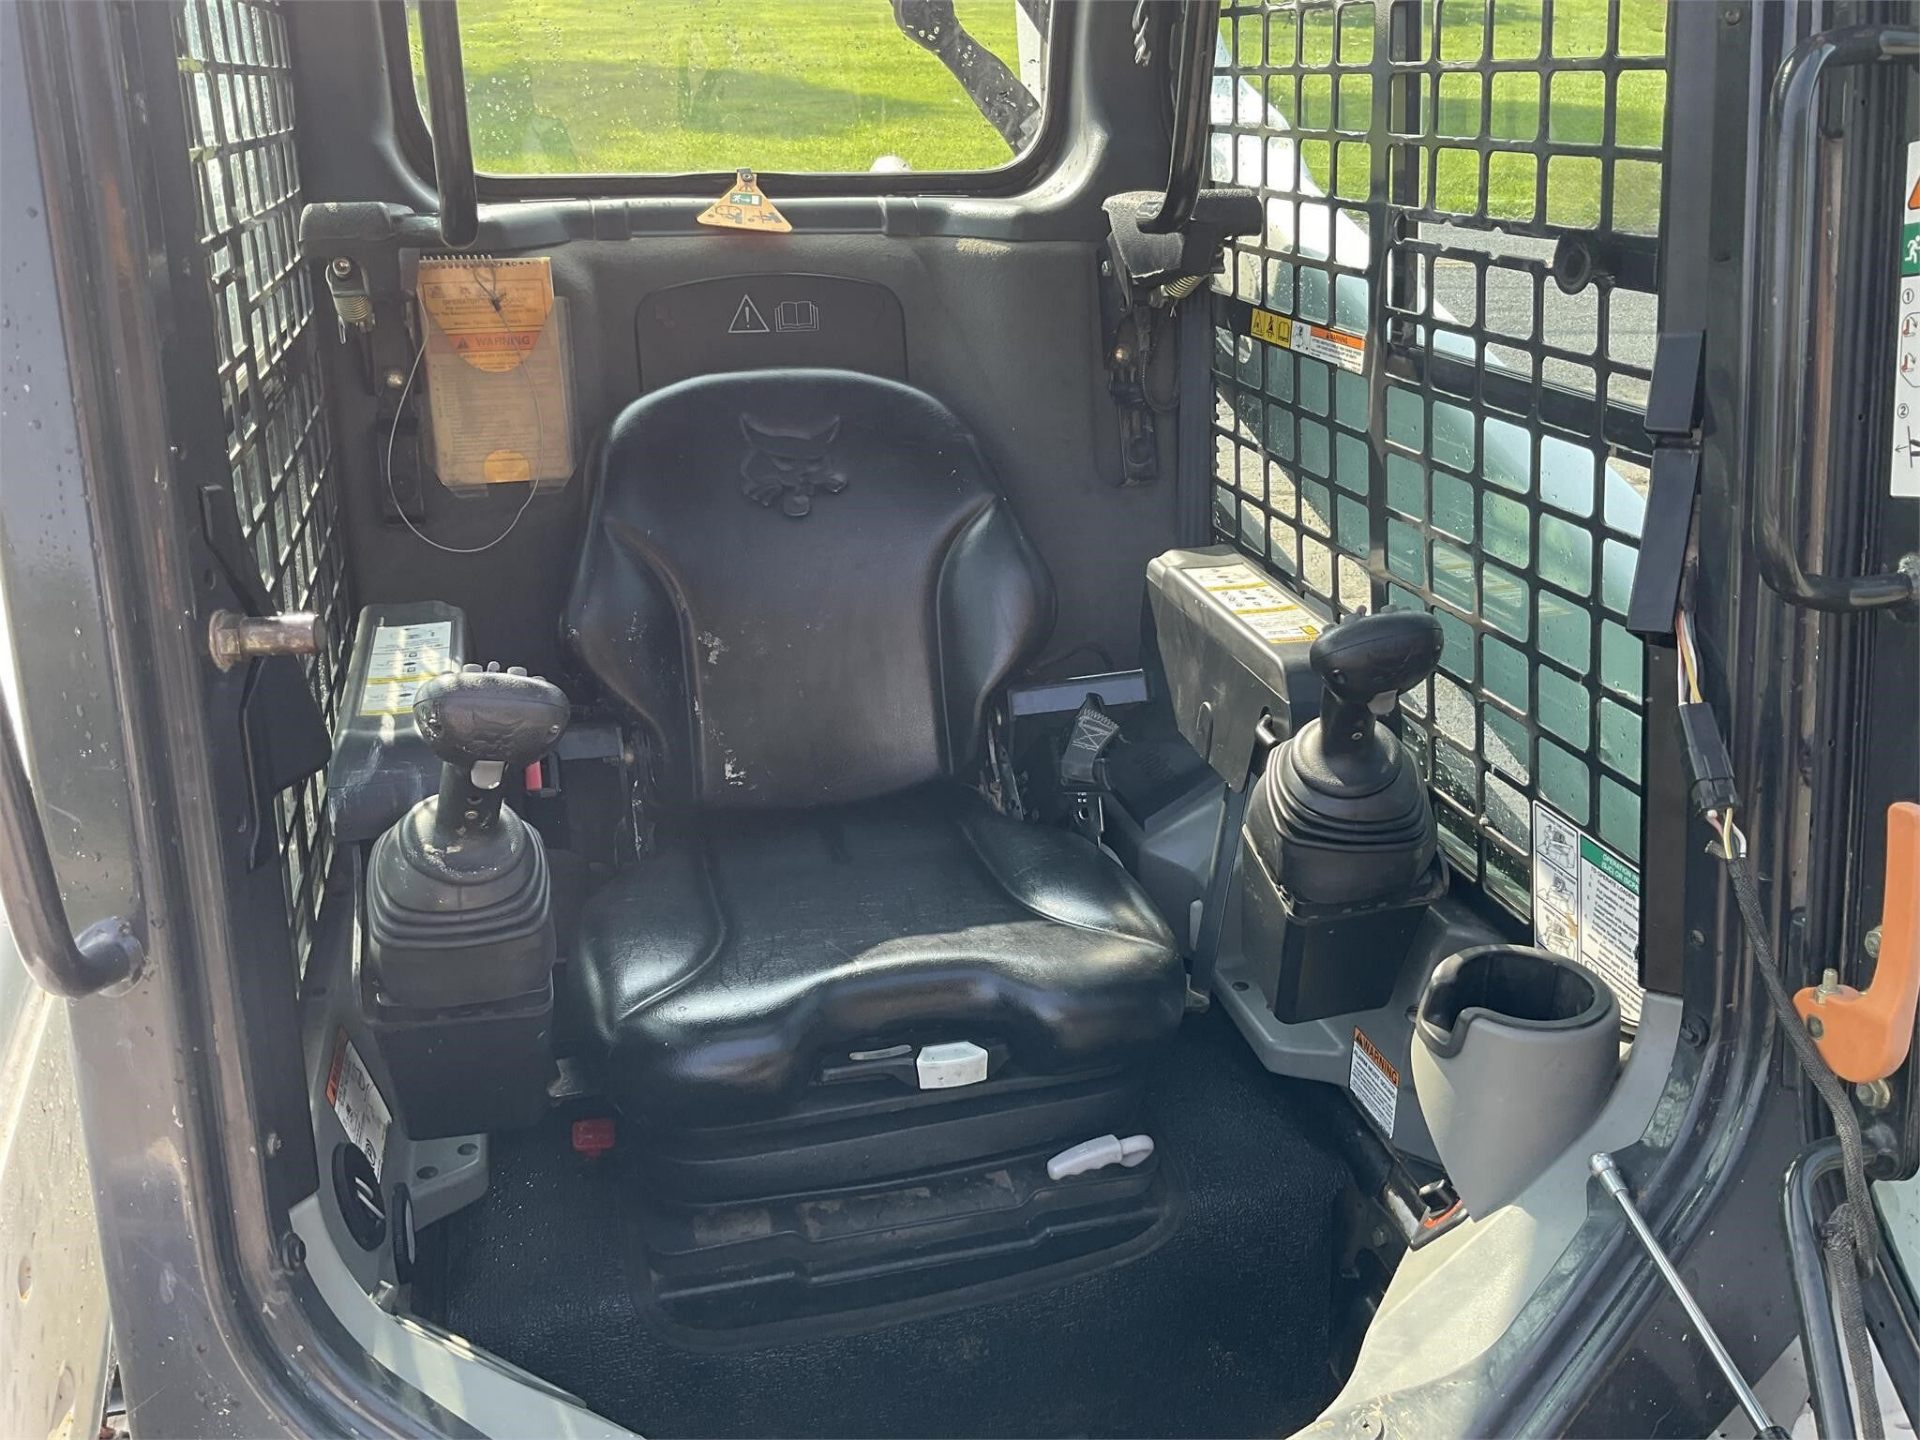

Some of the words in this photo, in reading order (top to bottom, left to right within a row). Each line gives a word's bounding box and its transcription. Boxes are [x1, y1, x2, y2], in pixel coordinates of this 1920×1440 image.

[475, 336, 530, 346] WARNING
[1602, 853, 1632, 878] OPERATION
[1363, 1038, 1397, 1085] WARNING
